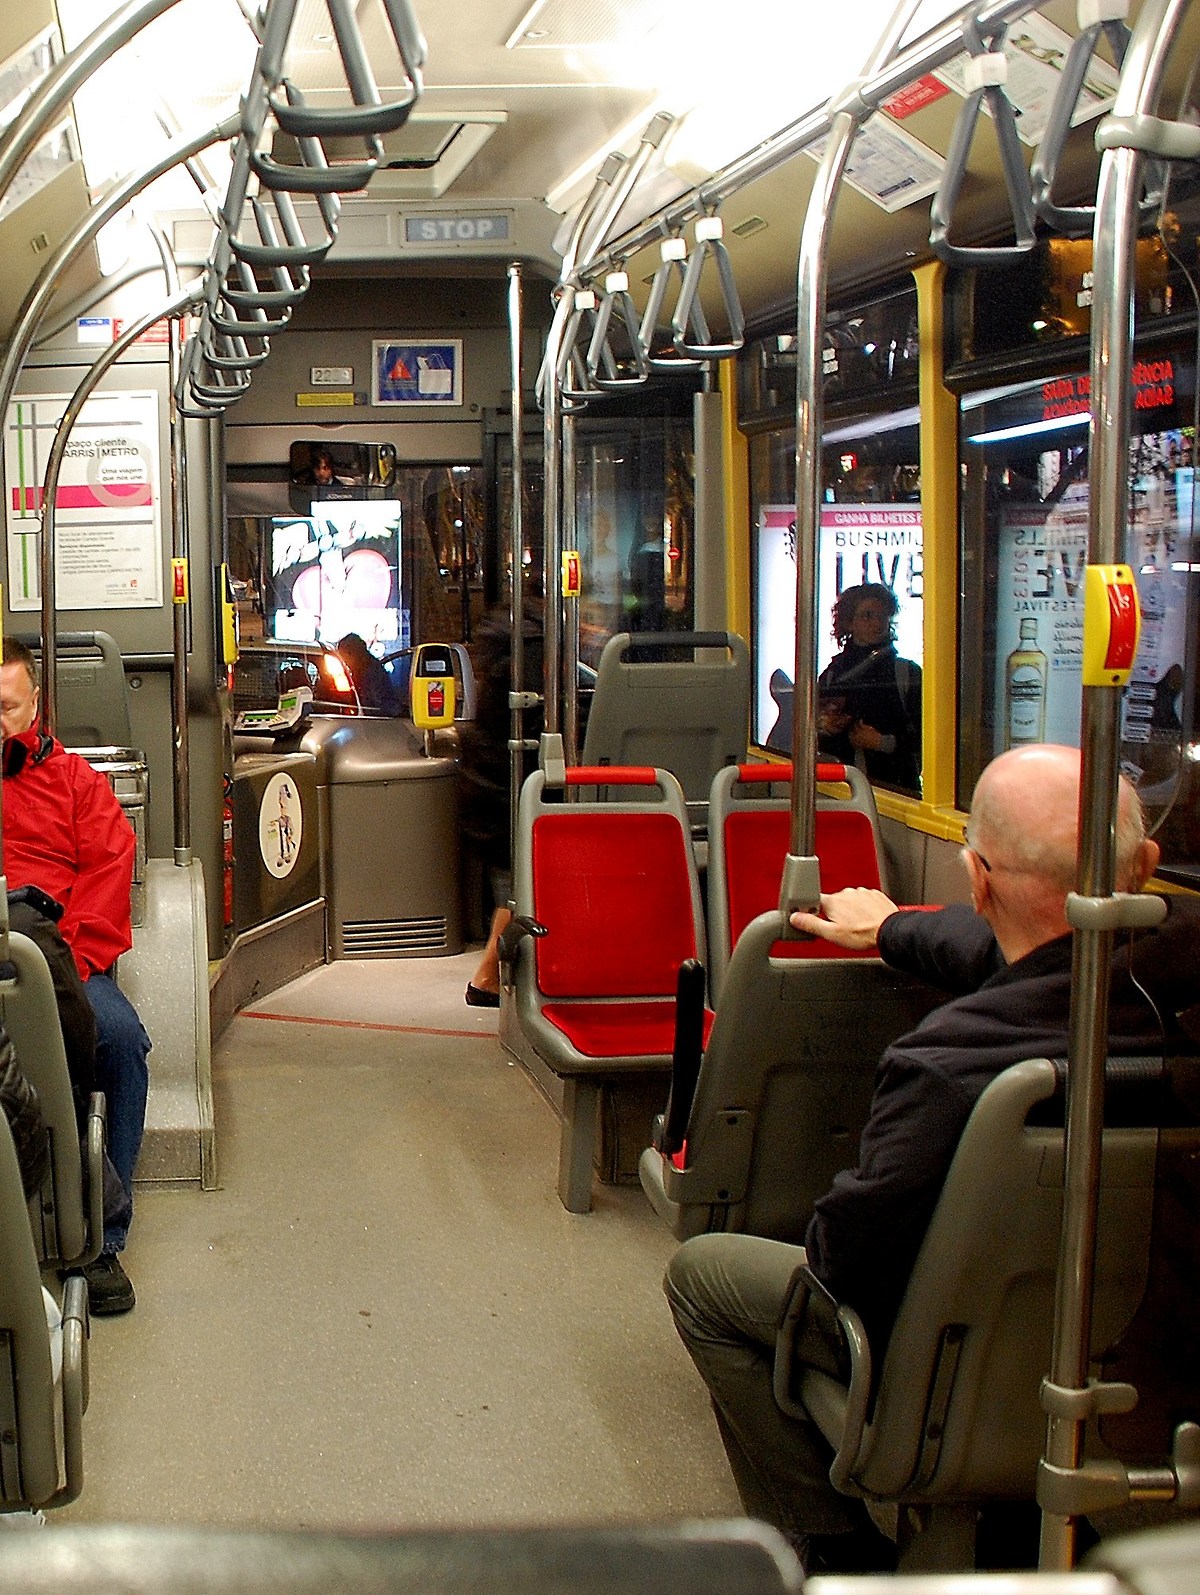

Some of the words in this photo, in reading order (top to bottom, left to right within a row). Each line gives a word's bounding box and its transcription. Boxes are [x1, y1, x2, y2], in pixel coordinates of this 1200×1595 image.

[421, 219, 493, 240] STOP
[66, 440, 92, 448] paço
[94, 438, 127, 447] cliente
[62, 449, 95, 458] ARRIS
[101, 447, 139, 457] METRO
